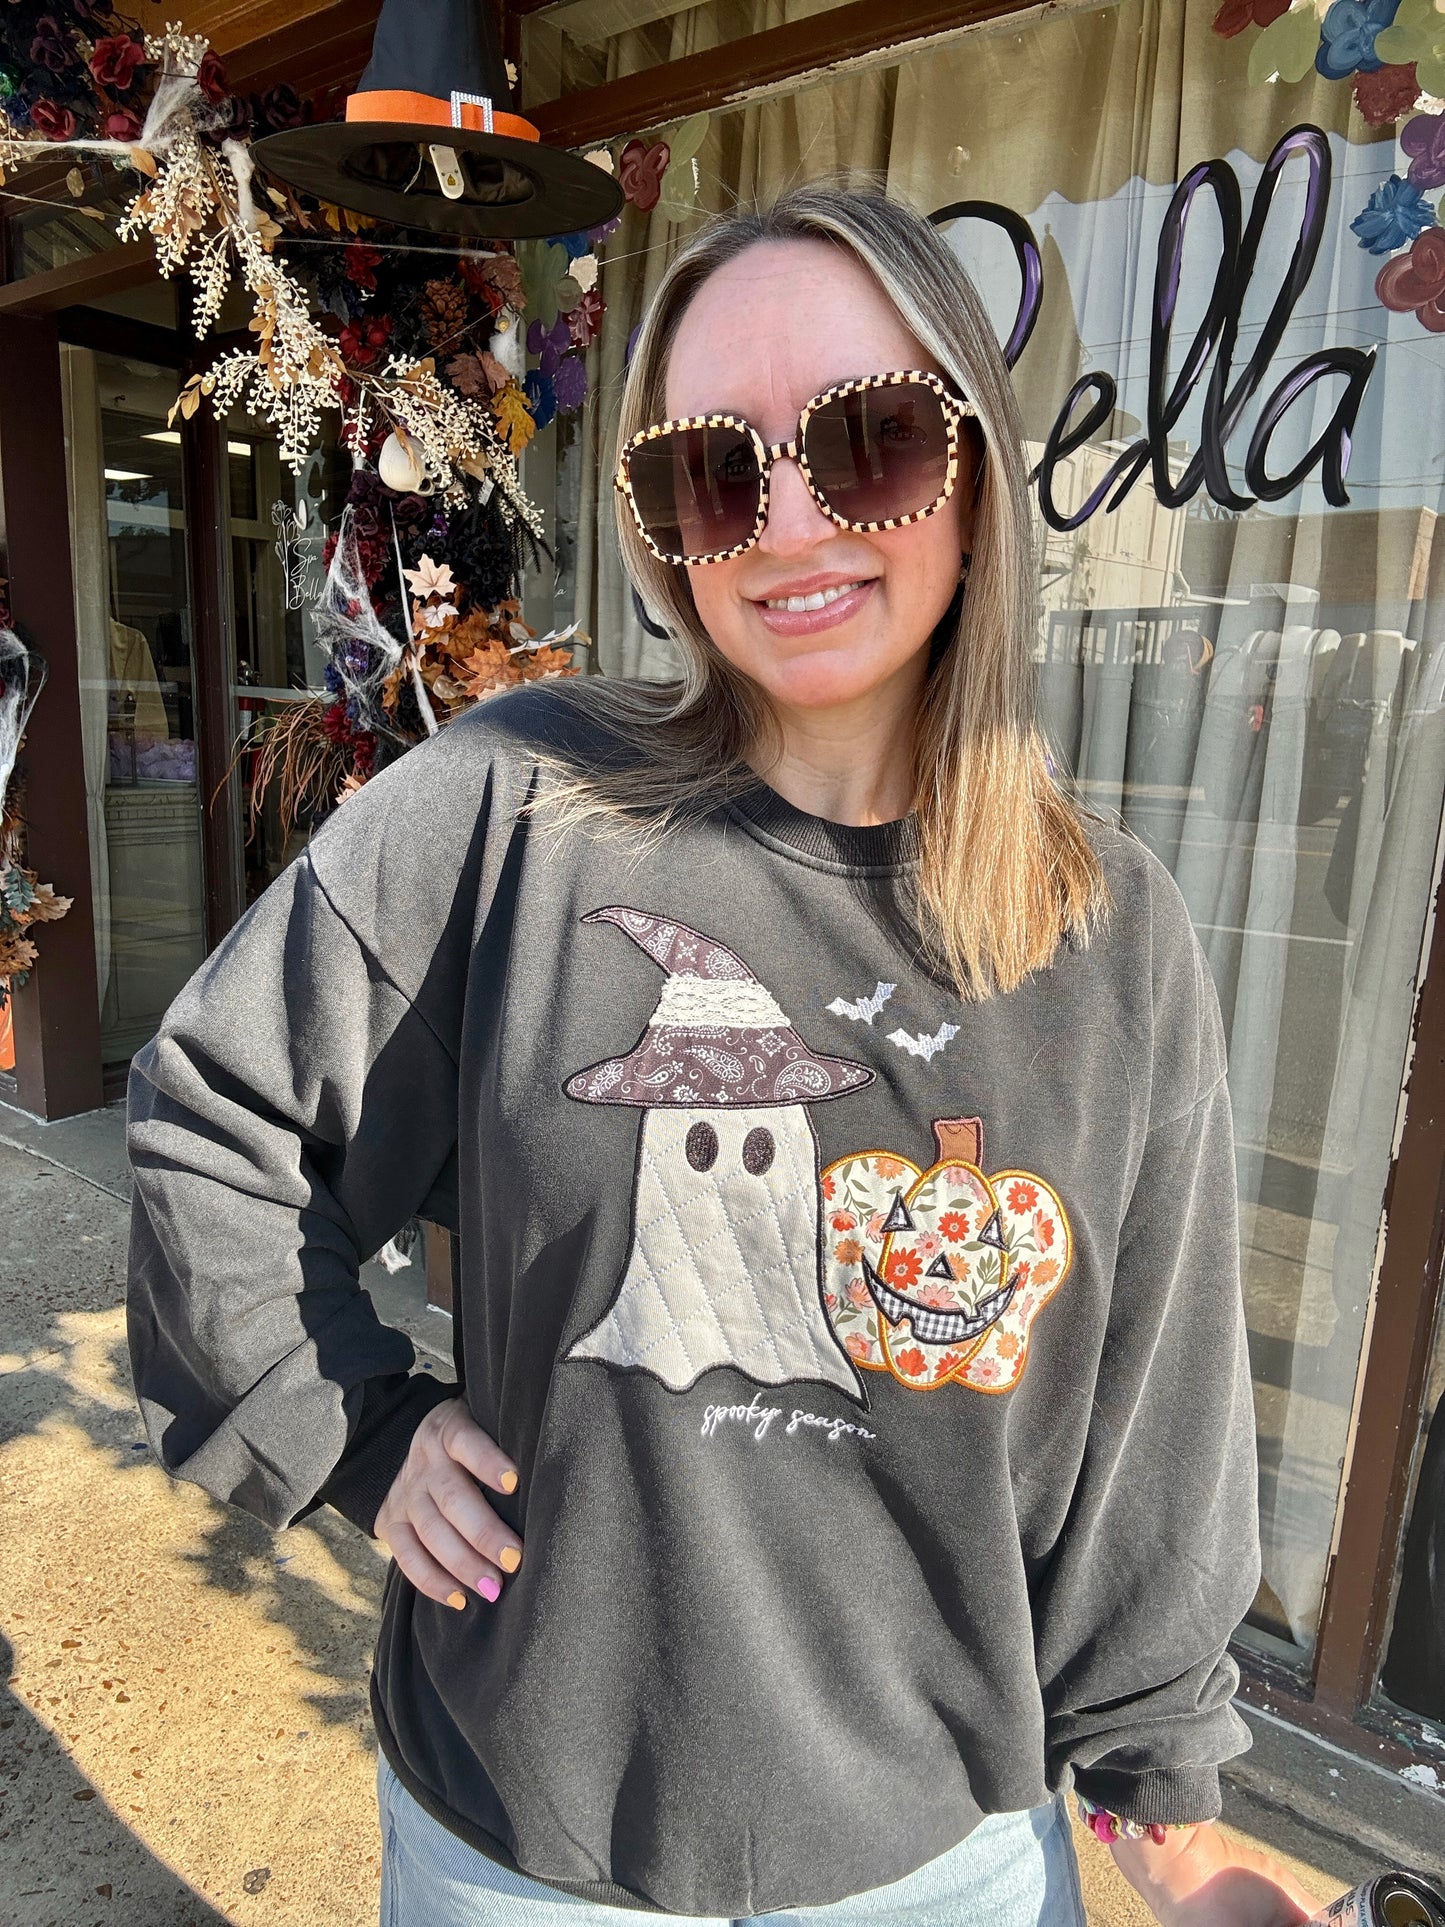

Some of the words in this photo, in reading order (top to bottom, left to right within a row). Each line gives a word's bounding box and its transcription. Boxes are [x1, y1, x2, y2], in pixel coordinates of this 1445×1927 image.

[290, 537, 319, 576] Spa
[701, 1392, 782, 1440] spooky
[786, 1409, 877, 1440] season
